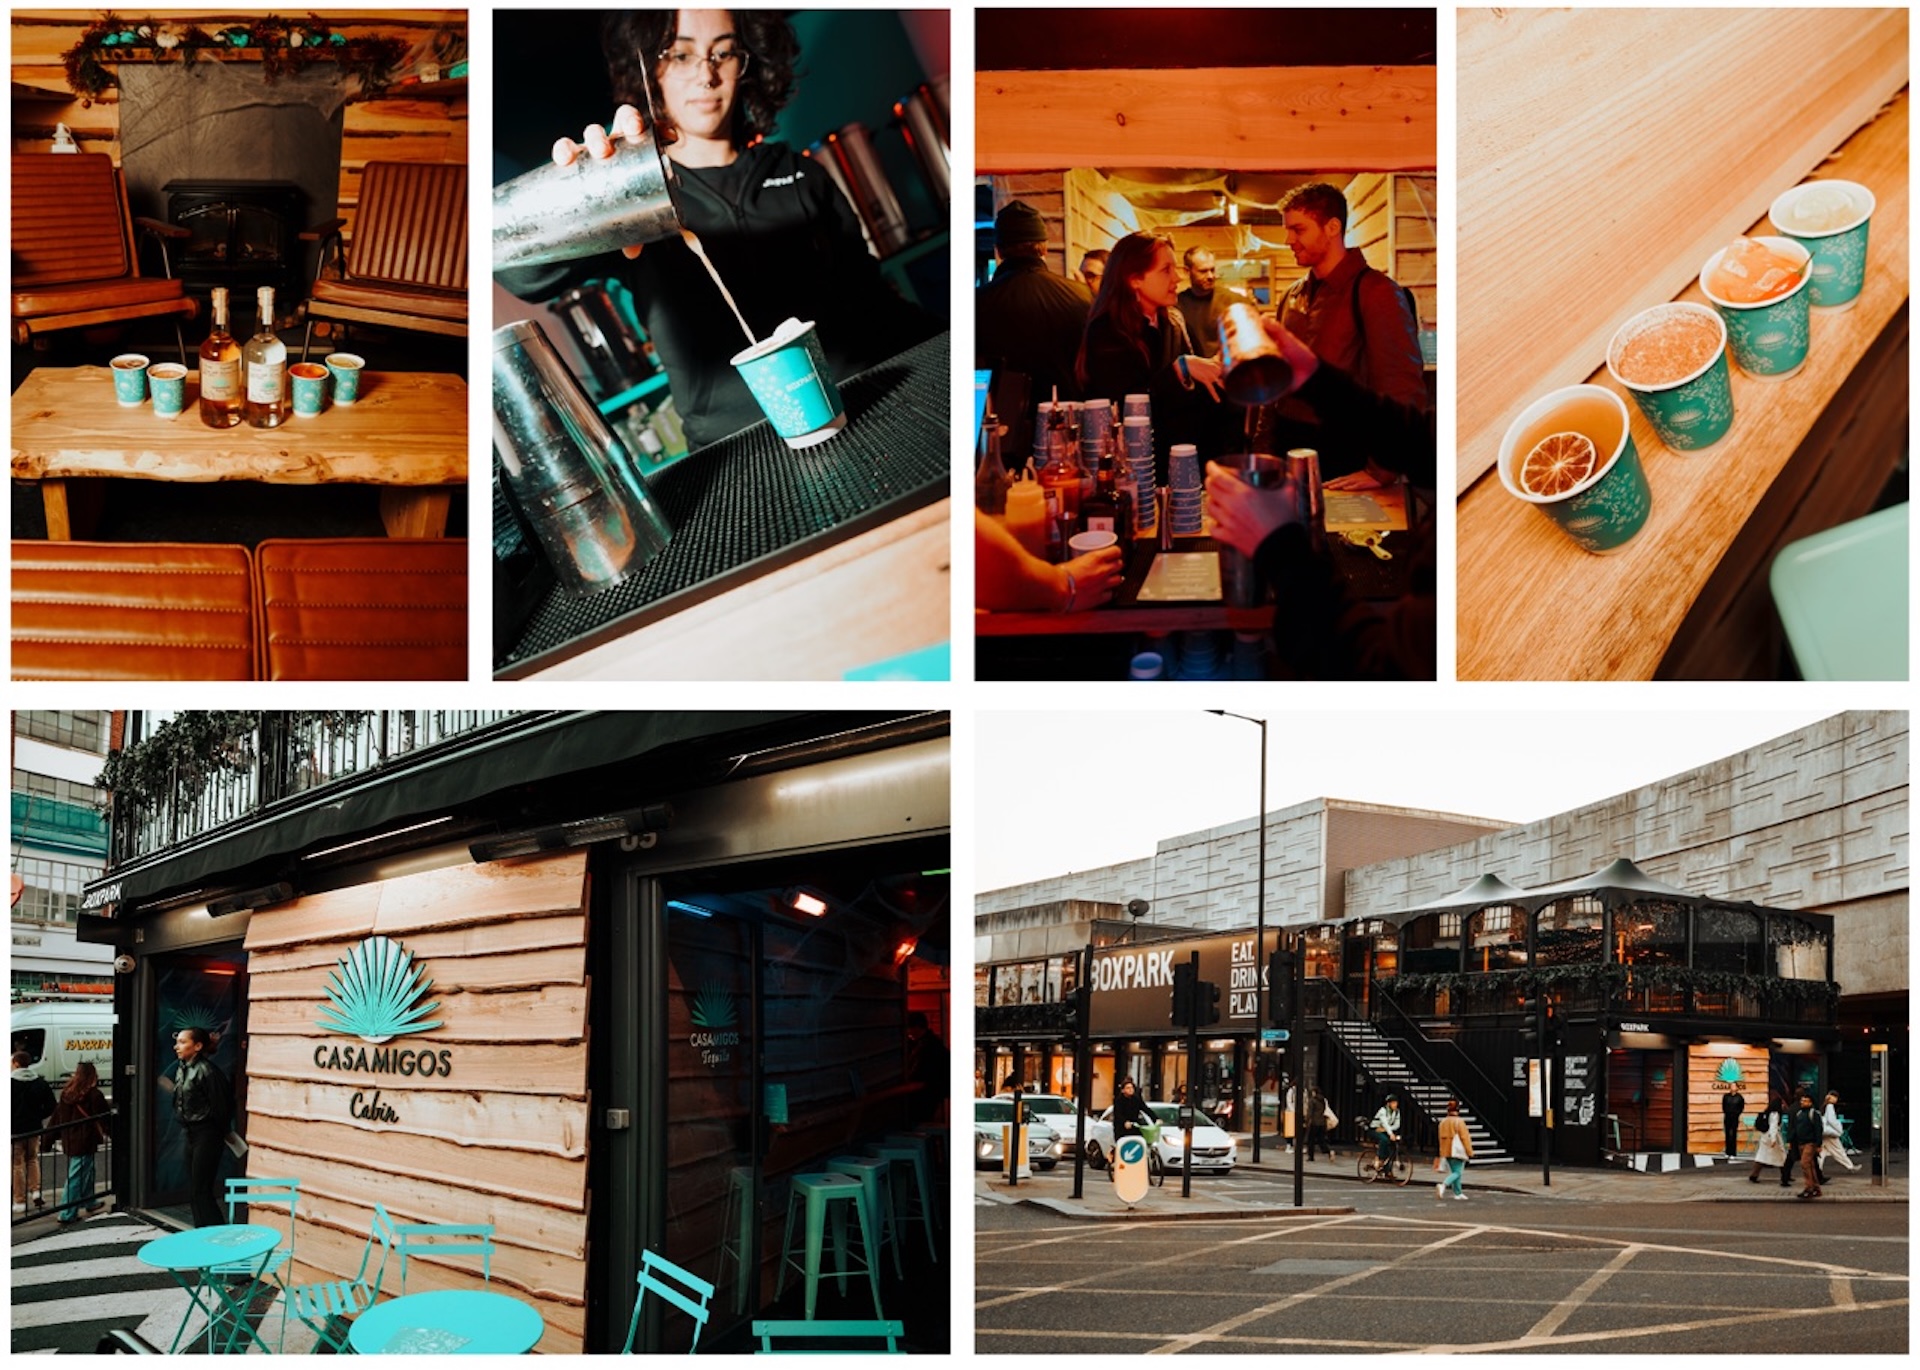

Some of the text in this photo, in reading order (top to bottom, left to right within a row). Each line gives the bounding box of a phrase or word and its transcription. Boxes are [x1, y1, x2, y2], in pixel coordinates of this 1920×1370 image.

[1090, 950, 1175, 992] BOXPARK
[689, 1031, 739, 1048] CASAMIGOS
[313, 1044, 452, 1077] CASAMIGOS
[350, 1091, 399, 1123] Cabin
